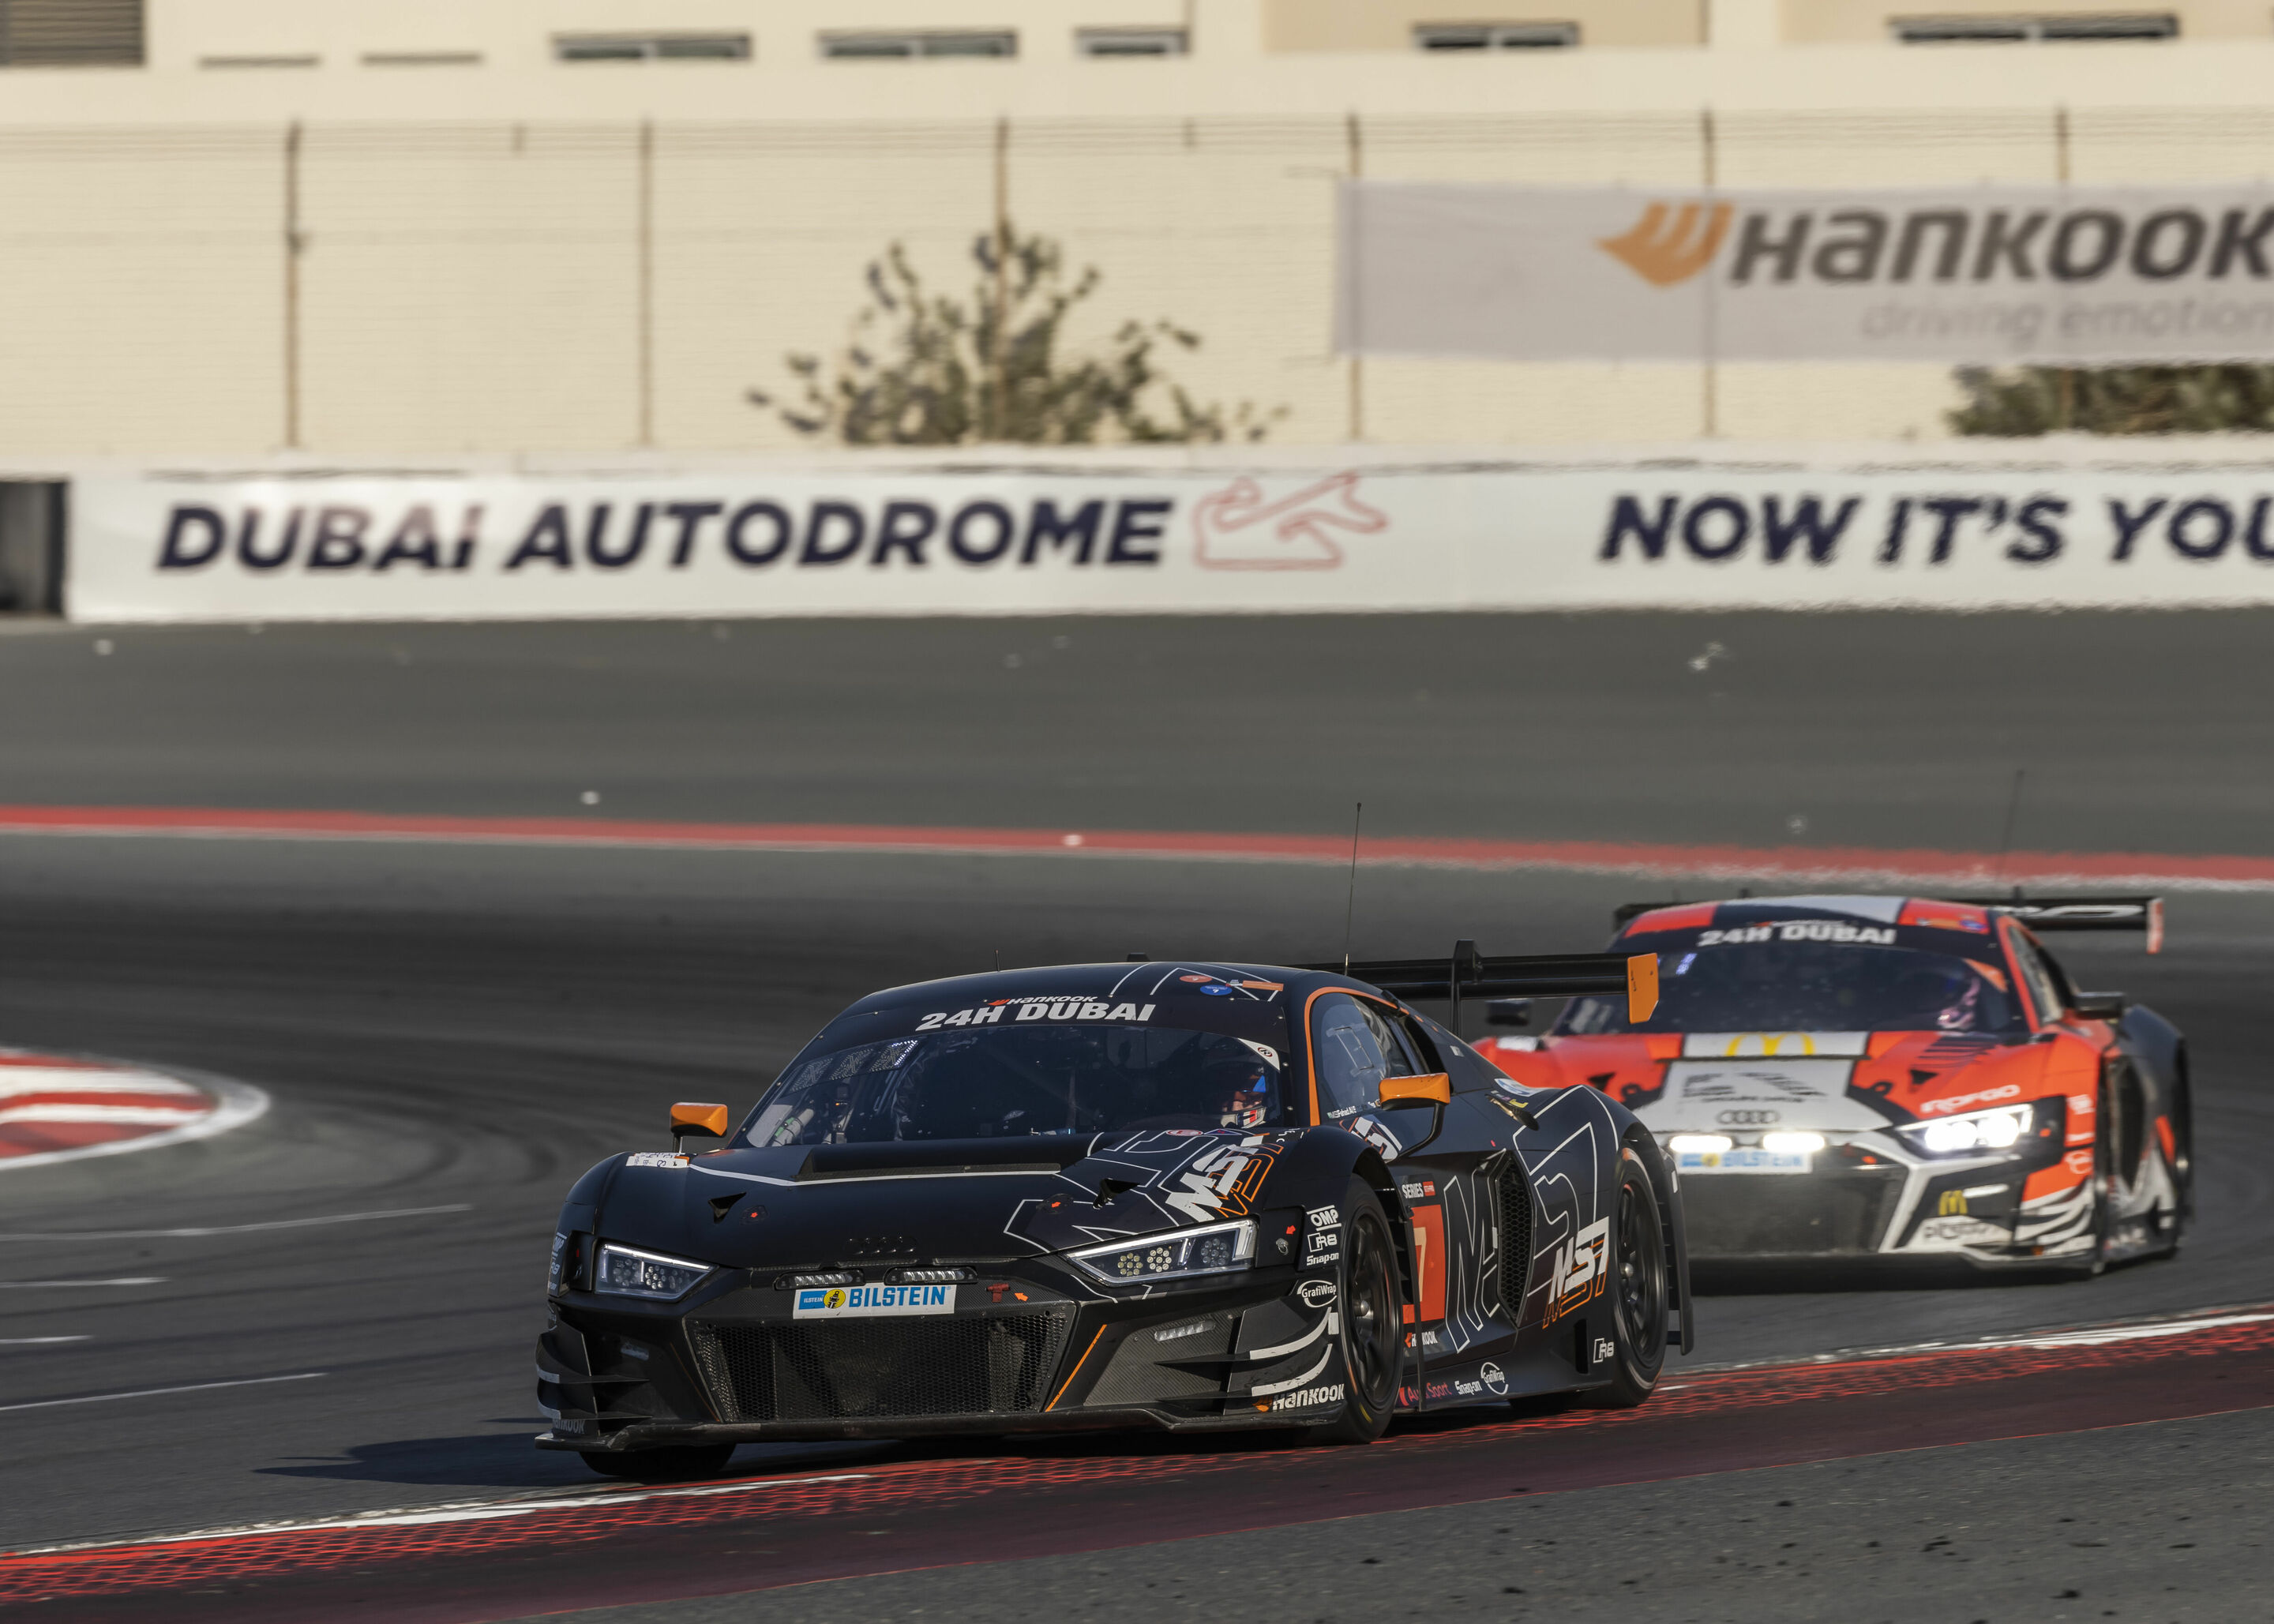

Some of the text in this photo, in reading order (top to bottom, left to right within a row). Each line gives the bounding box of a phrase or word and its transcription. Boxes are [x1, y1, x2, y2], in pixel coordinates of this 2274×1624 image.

[1860, 299, 2045, 352] driving
[157, 498, 1173, 572] DUBAI AUTODROME
[1599, 493, 1863, 564] NOW
[1876, 495, 2073, 564] IT'S
[1696, 925, 1897, 947] 24H DUBAI
[915, 1002, 1156, 1031] 24H DUBAI
[1311, 1209, 1339, 1227] OMP
[1313, 1233, 1338, 1249] R8
[1306, 1252, 1339, 1266] Snap-on
[849, 1286, 946, 1308] BILSTEIN
[1301, 1285, 1337, 1299] GrafiWrap
[1412, 1331, 1438, 1347] HKOOK
[1596, 1341, 1614, 1360] R8
[1427, 1382, 1453, 1400] Sport
[1454, 1380, 1483, 1395] Snap-on
